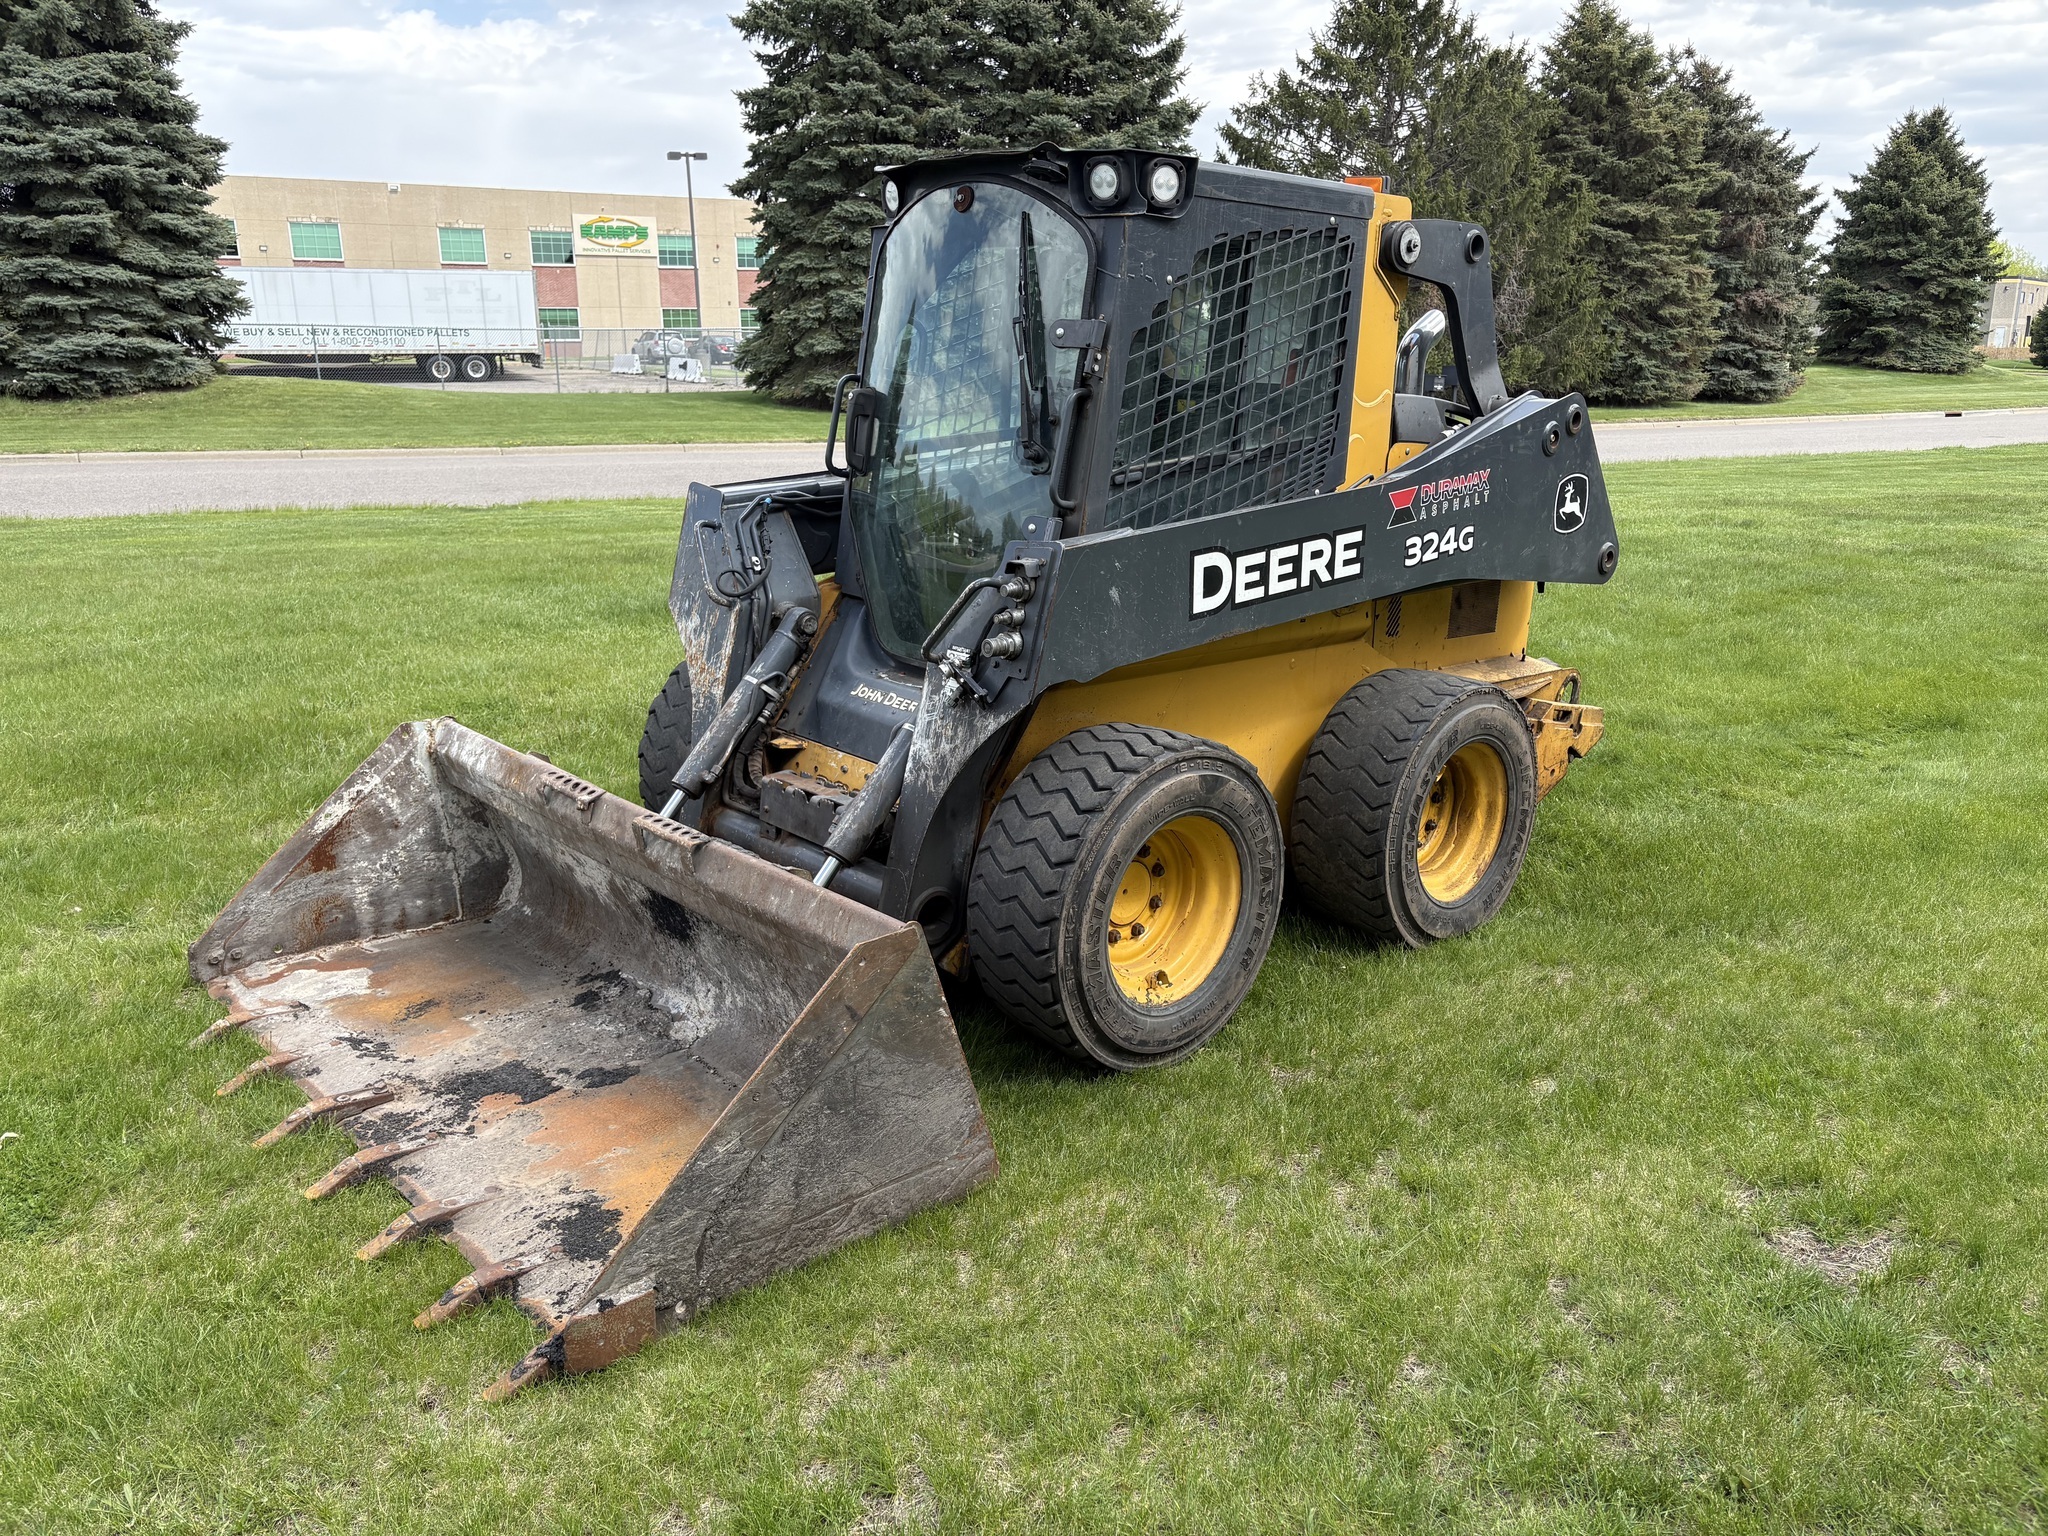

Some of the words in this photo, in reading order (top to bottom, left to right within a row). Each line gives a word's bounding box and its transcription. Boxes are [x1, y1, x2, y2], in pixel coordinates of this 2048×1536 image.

[580, 224, 649, 240] KAMPS
[223, 327, 240, 336] WE
[243, 328, 264, 336] BUY
[267, 328, 275, 336] &
[277, 328, 304, 336] SELL
[306, 328, 330, 336] NEW
[333, 328, 340, 336] &
[342, 328, 425, 337] RECONDITIONED
[427, 329, 470, 337] PALLETS
[302, 337, 328, 346] CALL
[1420, 468, 1491, 507] DURAMAX
[1420, 489, 1490, 521] ASPHALT
[1404, 525, 1474, 566] 324G
[1192, 529, 1363, 615] DEERE
[850, 683, 884, 703] JOHN
[882, 692, 919, 713] DEER
[1404, 729, 1460, 903] LIFEMASTER
[1221, 779, 1276, 973] LIFEMASTER
[1084, 852, 1145, 1046] LIFEMASTER
